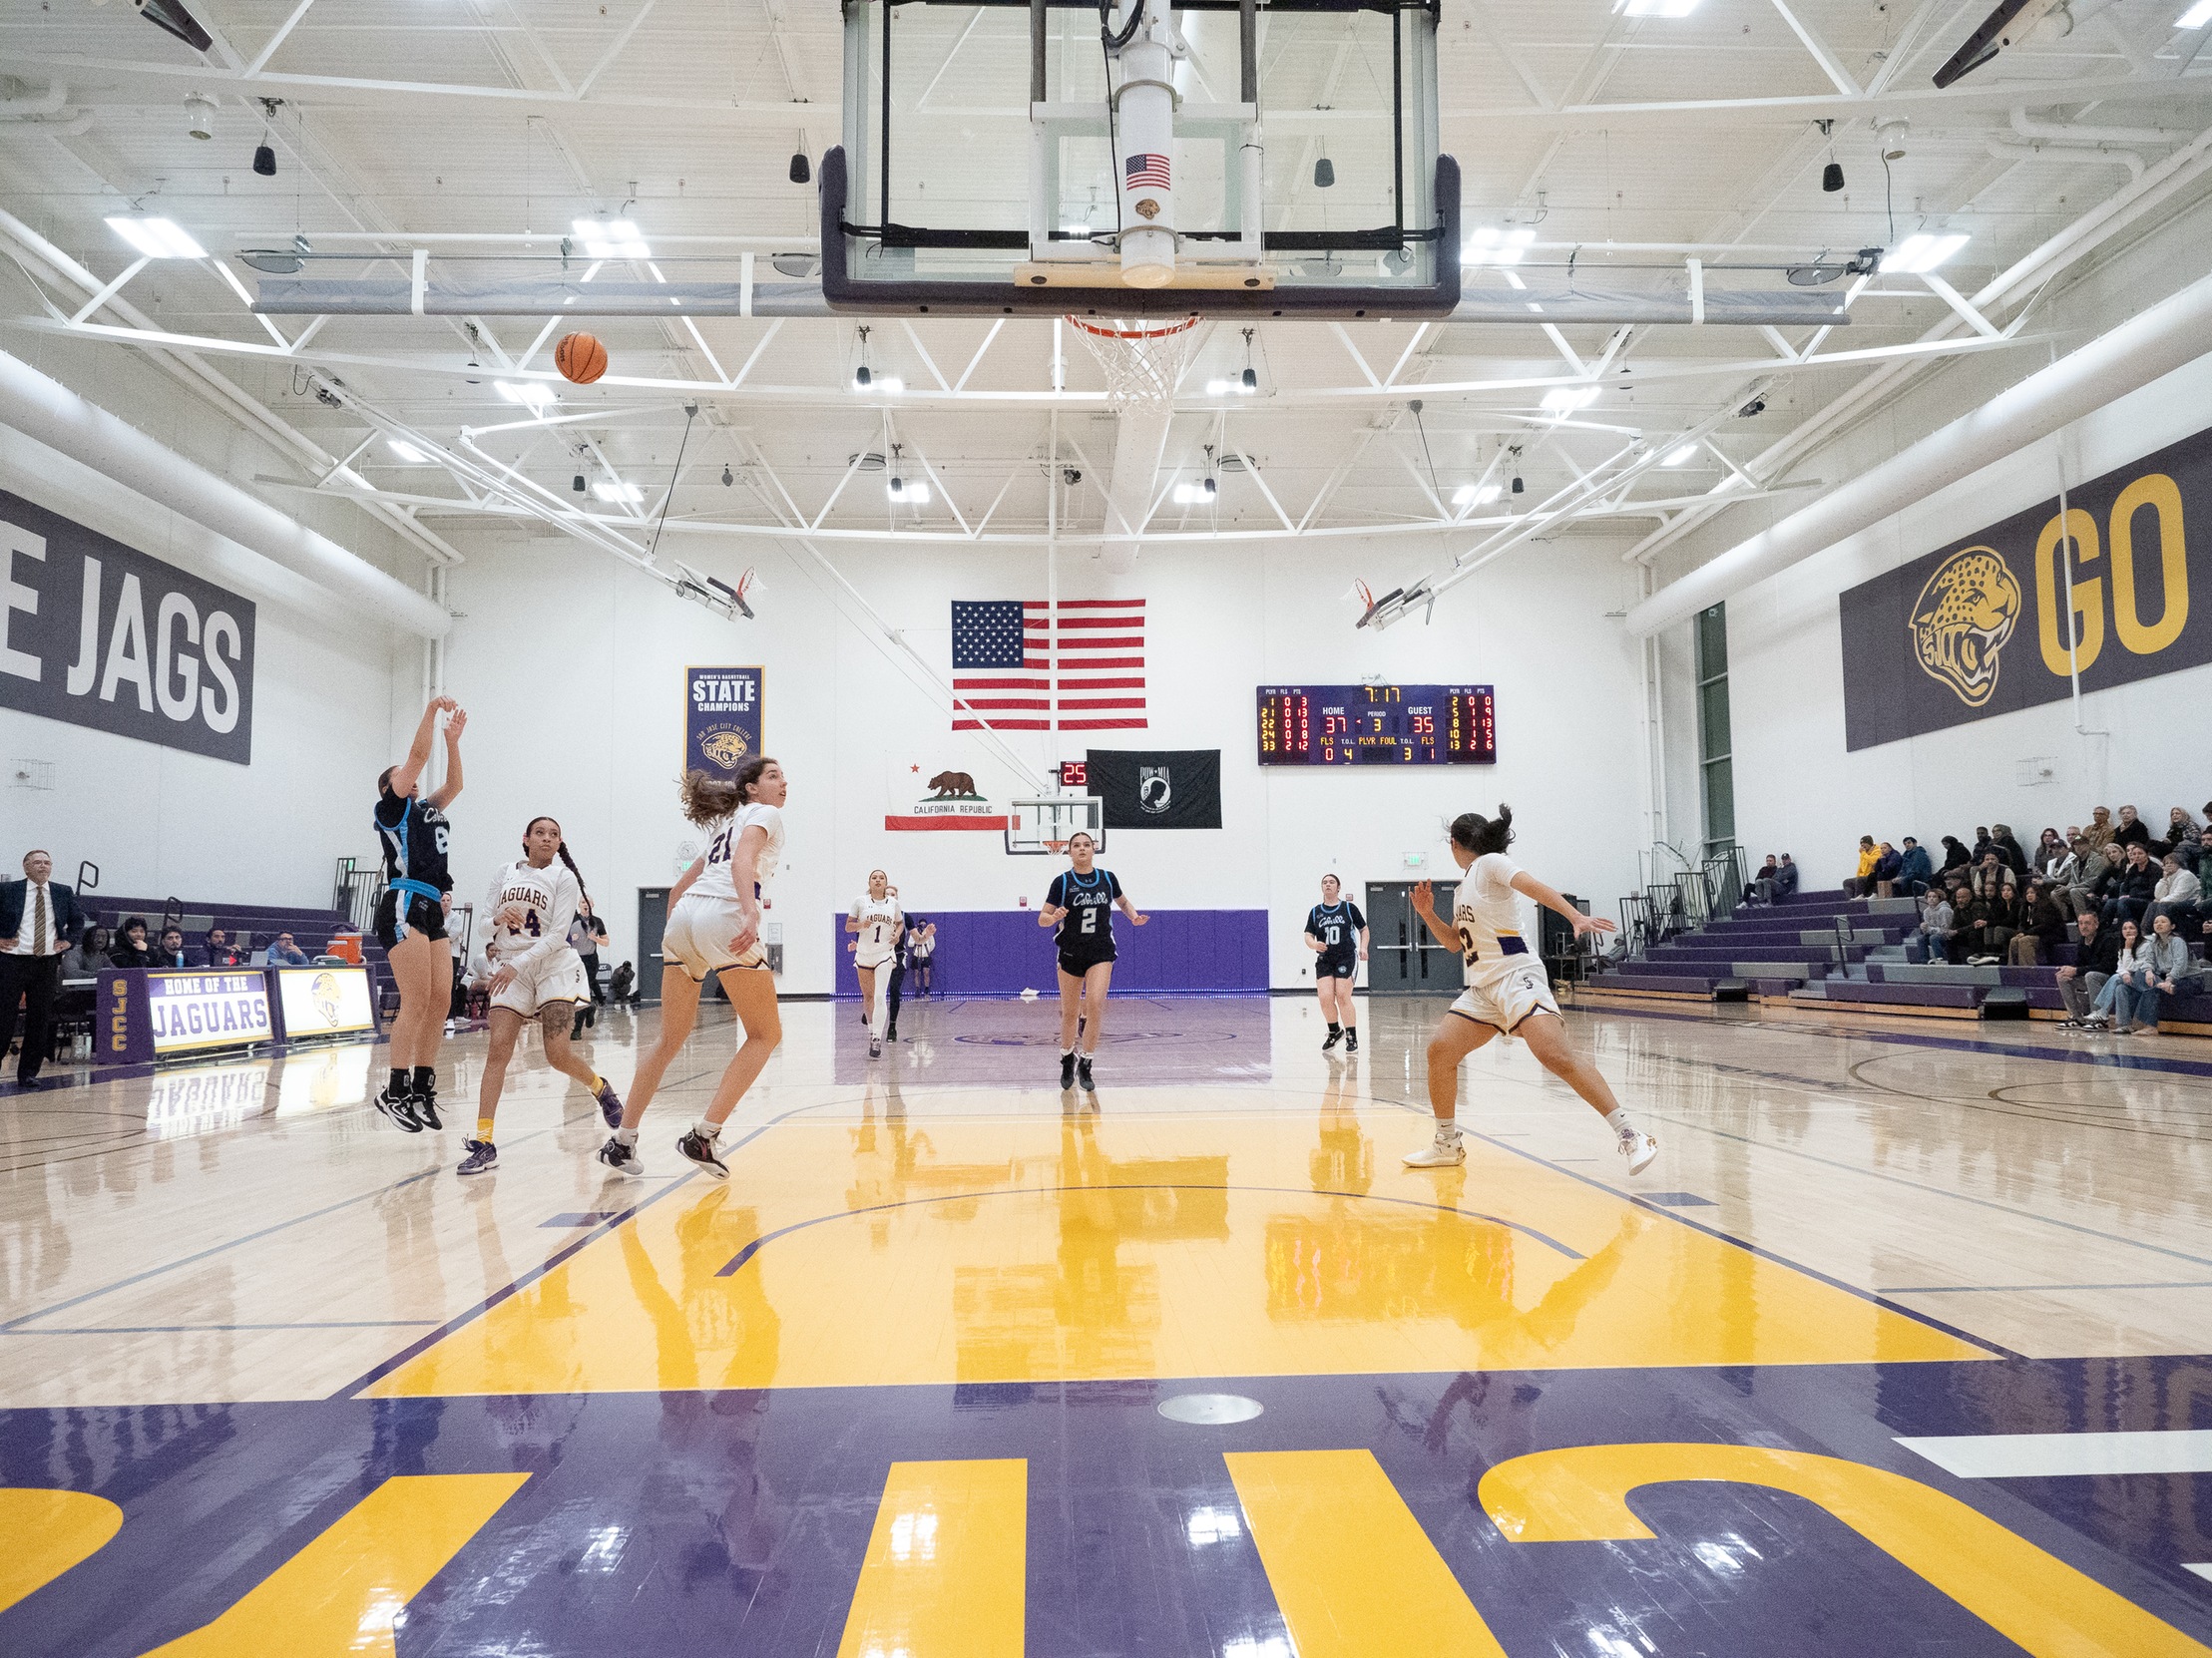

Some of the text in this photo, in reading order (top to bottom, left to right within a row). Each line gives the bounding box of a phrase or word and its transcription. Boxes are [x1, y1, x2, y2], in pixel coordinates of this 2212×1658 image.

[2035, 473, 2189, 677] GO
[67, 555, 241, 733] JAGS
[1922, 623, 1972, 670] SJCC
[692, 680, 755, 702] STATE
[1364, 686, 1401, 703] 7:17
[697, 702, 749, 711] CHAMPIONS
[1284, 696, 1291, 706] 0
[1301, 696, 1308, 706] 3
[1452, 695, 1492, 706] 2 0 0
[1261, 707, 1308, 718] 21 0 13
[1322, 706, 1345, 715] HOME
[1408, 706, 1433, 715] GUEST
[1452, 707, 1459, 717] 5
[1485, 706, 1492, 716] 9
[1261, 718, 1308, 729] 22 0 0
[1326, 716, 1347, 733] 37
[1374, 718, 1381, 732] 3
[1413, 716, 1434, 733] 35
[1453, 718, 1460, 728] 8
[1482, 718, 1493, 728] 13
[1261, 729, 1309, 740] 24 0 8
[1320, 736, 1334, 745] FLS
[1358, 736, 1397, 745] PLYR FOUL
[1421, 736, 1435, 745] FLS
[1450, 729, 1460, 739] 10
[1486, 728, 1493, 739] 5
[1262, 740, 1309, 751] 33 2 12
[1450, 739, 1494, 750] 13 2 6
[1325, 747, 1334, 761] 0
[1344, 748, 1353, 760] 4
[1404, 747, 1412, 761] 3
[1064, 764, 1087, 783] 25
[914, 805, 993, 814] CALIFORNIA REPUBLIC
[707, 826, 733, 867] 21
[1073, 892, 1108, 907] Cabrillo
[1081, 908, 1098, 934] 2
[874, 925, 881, 944] 1
[1324, 926, 1340, 945] 10
[165, 976, 248, 996] HOME OF THE
[112, 979, 128, 1051] SJCC
[153, 999, 267, 1038] JAGUARS
